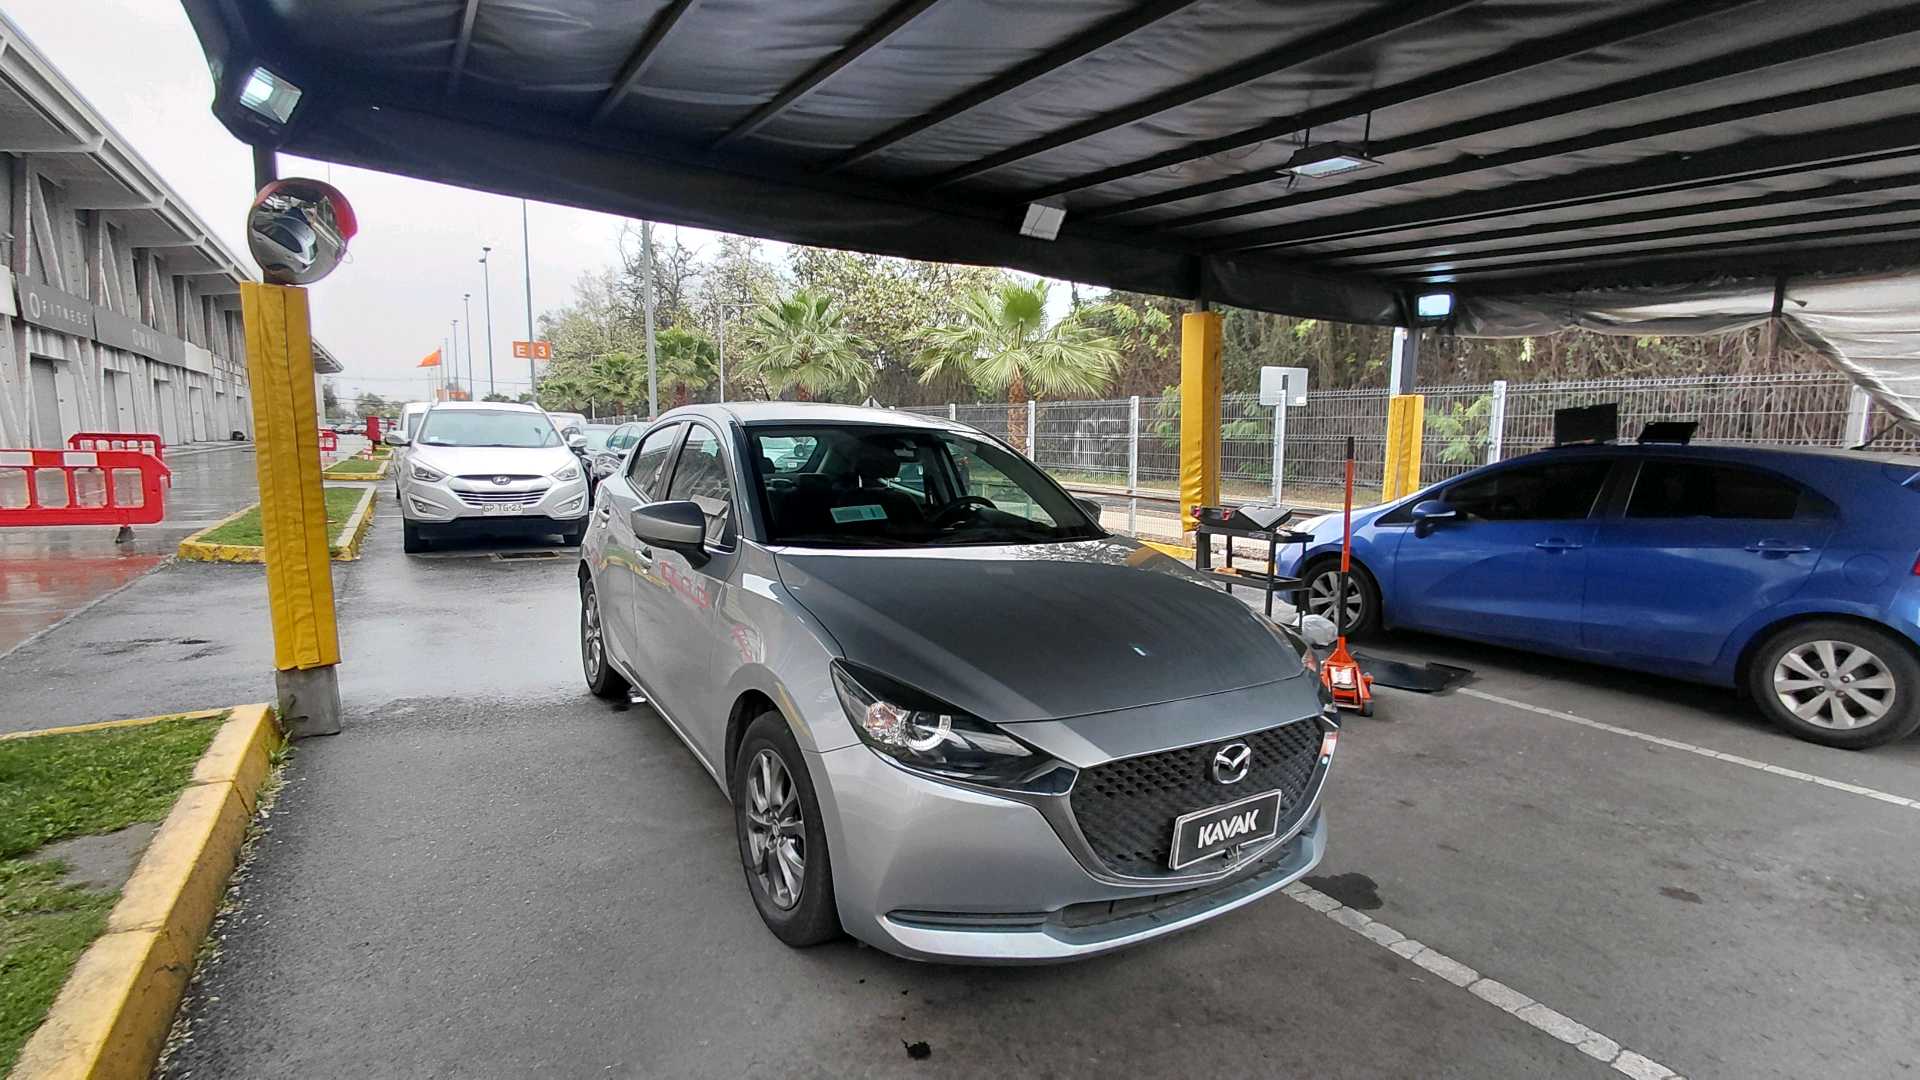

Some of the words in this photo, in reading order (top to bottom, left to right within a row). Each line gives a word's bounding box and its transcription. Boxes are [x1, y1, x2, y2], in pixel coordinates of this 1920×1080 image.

[42, 300, 88, 326] FITNESS
[516, 345, 526, 356] E
[538, 346, 546, 358] 3
[1198, 809, 1259, 849] KAVAK
